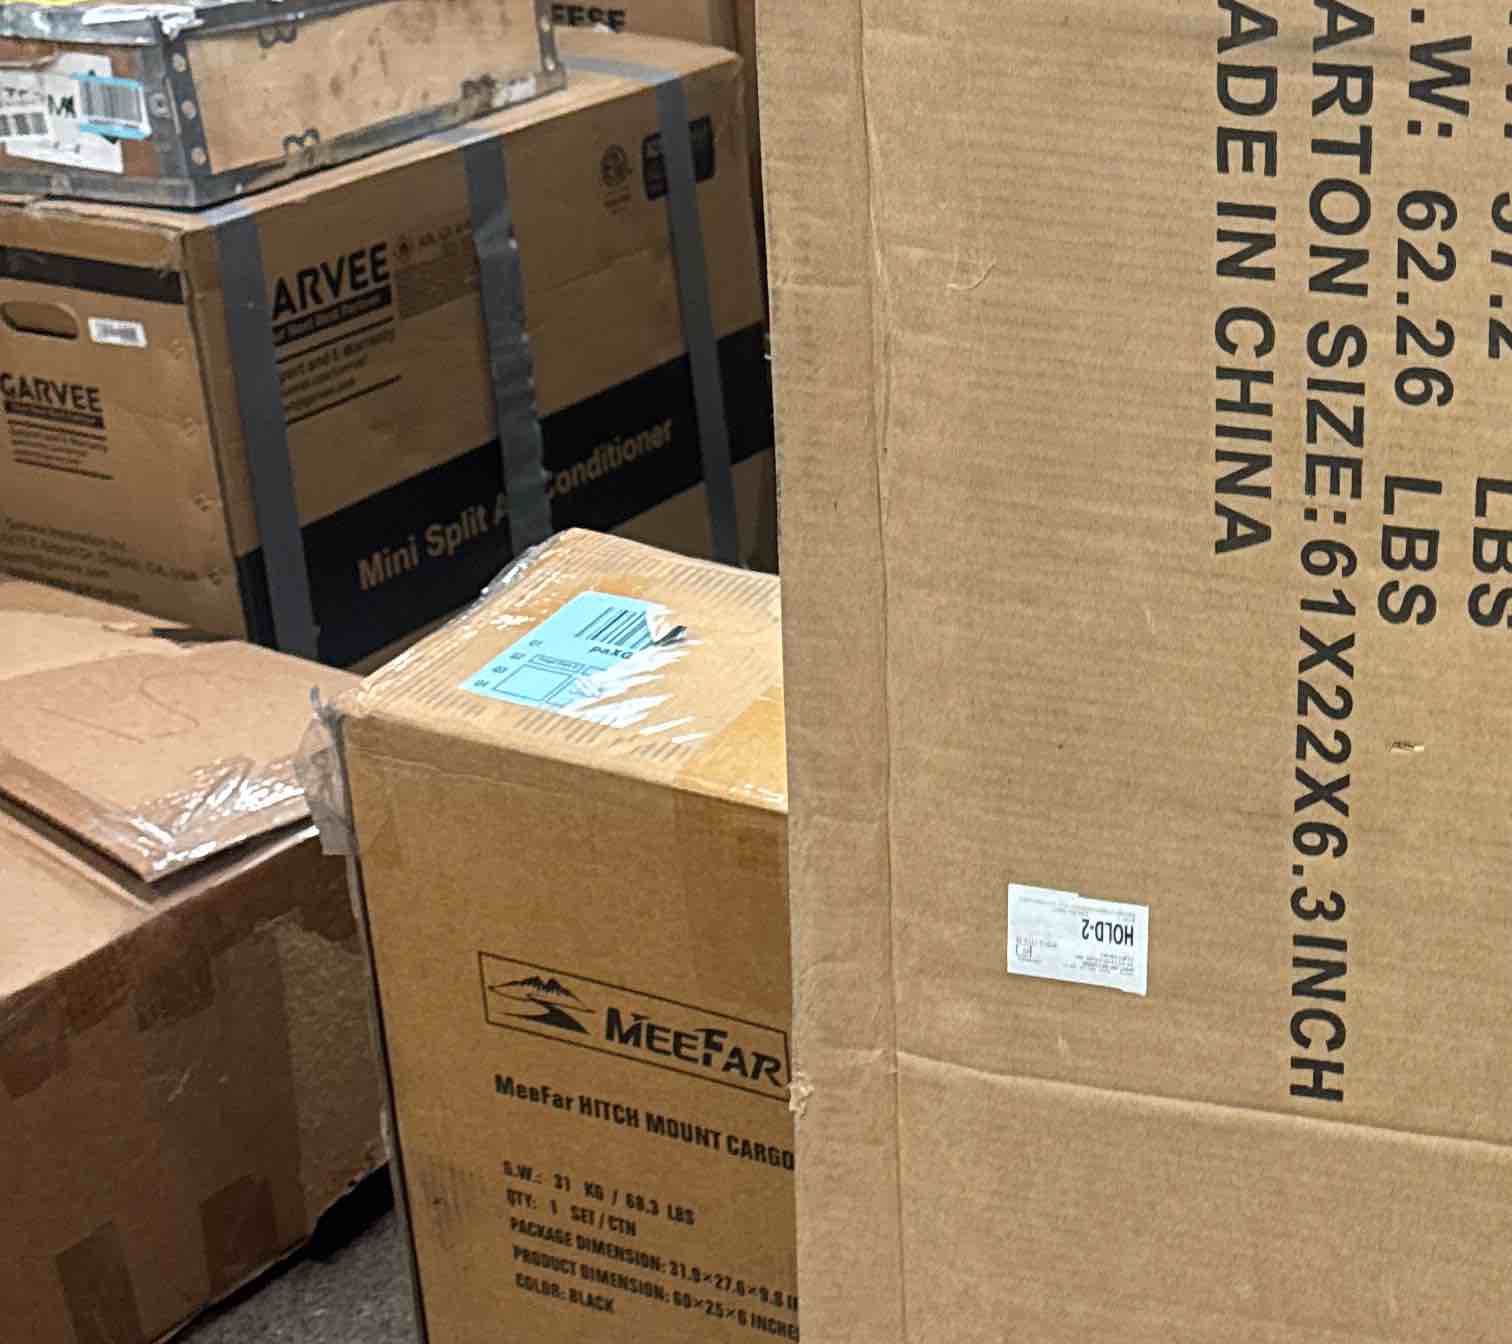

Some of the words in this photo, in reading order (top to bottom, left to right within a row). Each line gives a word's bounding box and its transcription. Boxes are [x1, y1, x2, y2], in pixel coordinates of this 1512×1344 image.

[1215, 201, 1277, 281] IN
[272, 241, 390, 320] ARVEE
[1395, 189, 1459, 407] 62.26
[0, 372, 103, 412] GARVEE
[1213, 306, 1276, 554] CHINA
[357, 533, 418, 590] Mini
[424, 503, 489, 555] Split
[1377, 474, 1443, 626] LBS
[1081, 918, 1135, 947] HOLD-2
[495, 1073, 573, 1111] MeeFar
[578, 1095, 640, 1128] HITCH
[646, 1112, 721, 1149] MOUNT
[727, 1134, 795, 1171] CARGO
[506, 1188, 538, 1211] QTY:
[553, 1173, 572, 1193] 31
[584, 1181, 605, 1202] KG
[667, 1203, 696, 1226] LBS
[509, 1216, 572, 1248] PACKAGE
[576, 1233, 668, 1274] DIMENSION:
[512, 1244, 577, 1277] PRODUCT
[580, 1262, 670, 1304] DIMENSION:
[515, 1272, 566, 1302] COLOR:
[569, 1287, 615, 1314] BLACK
